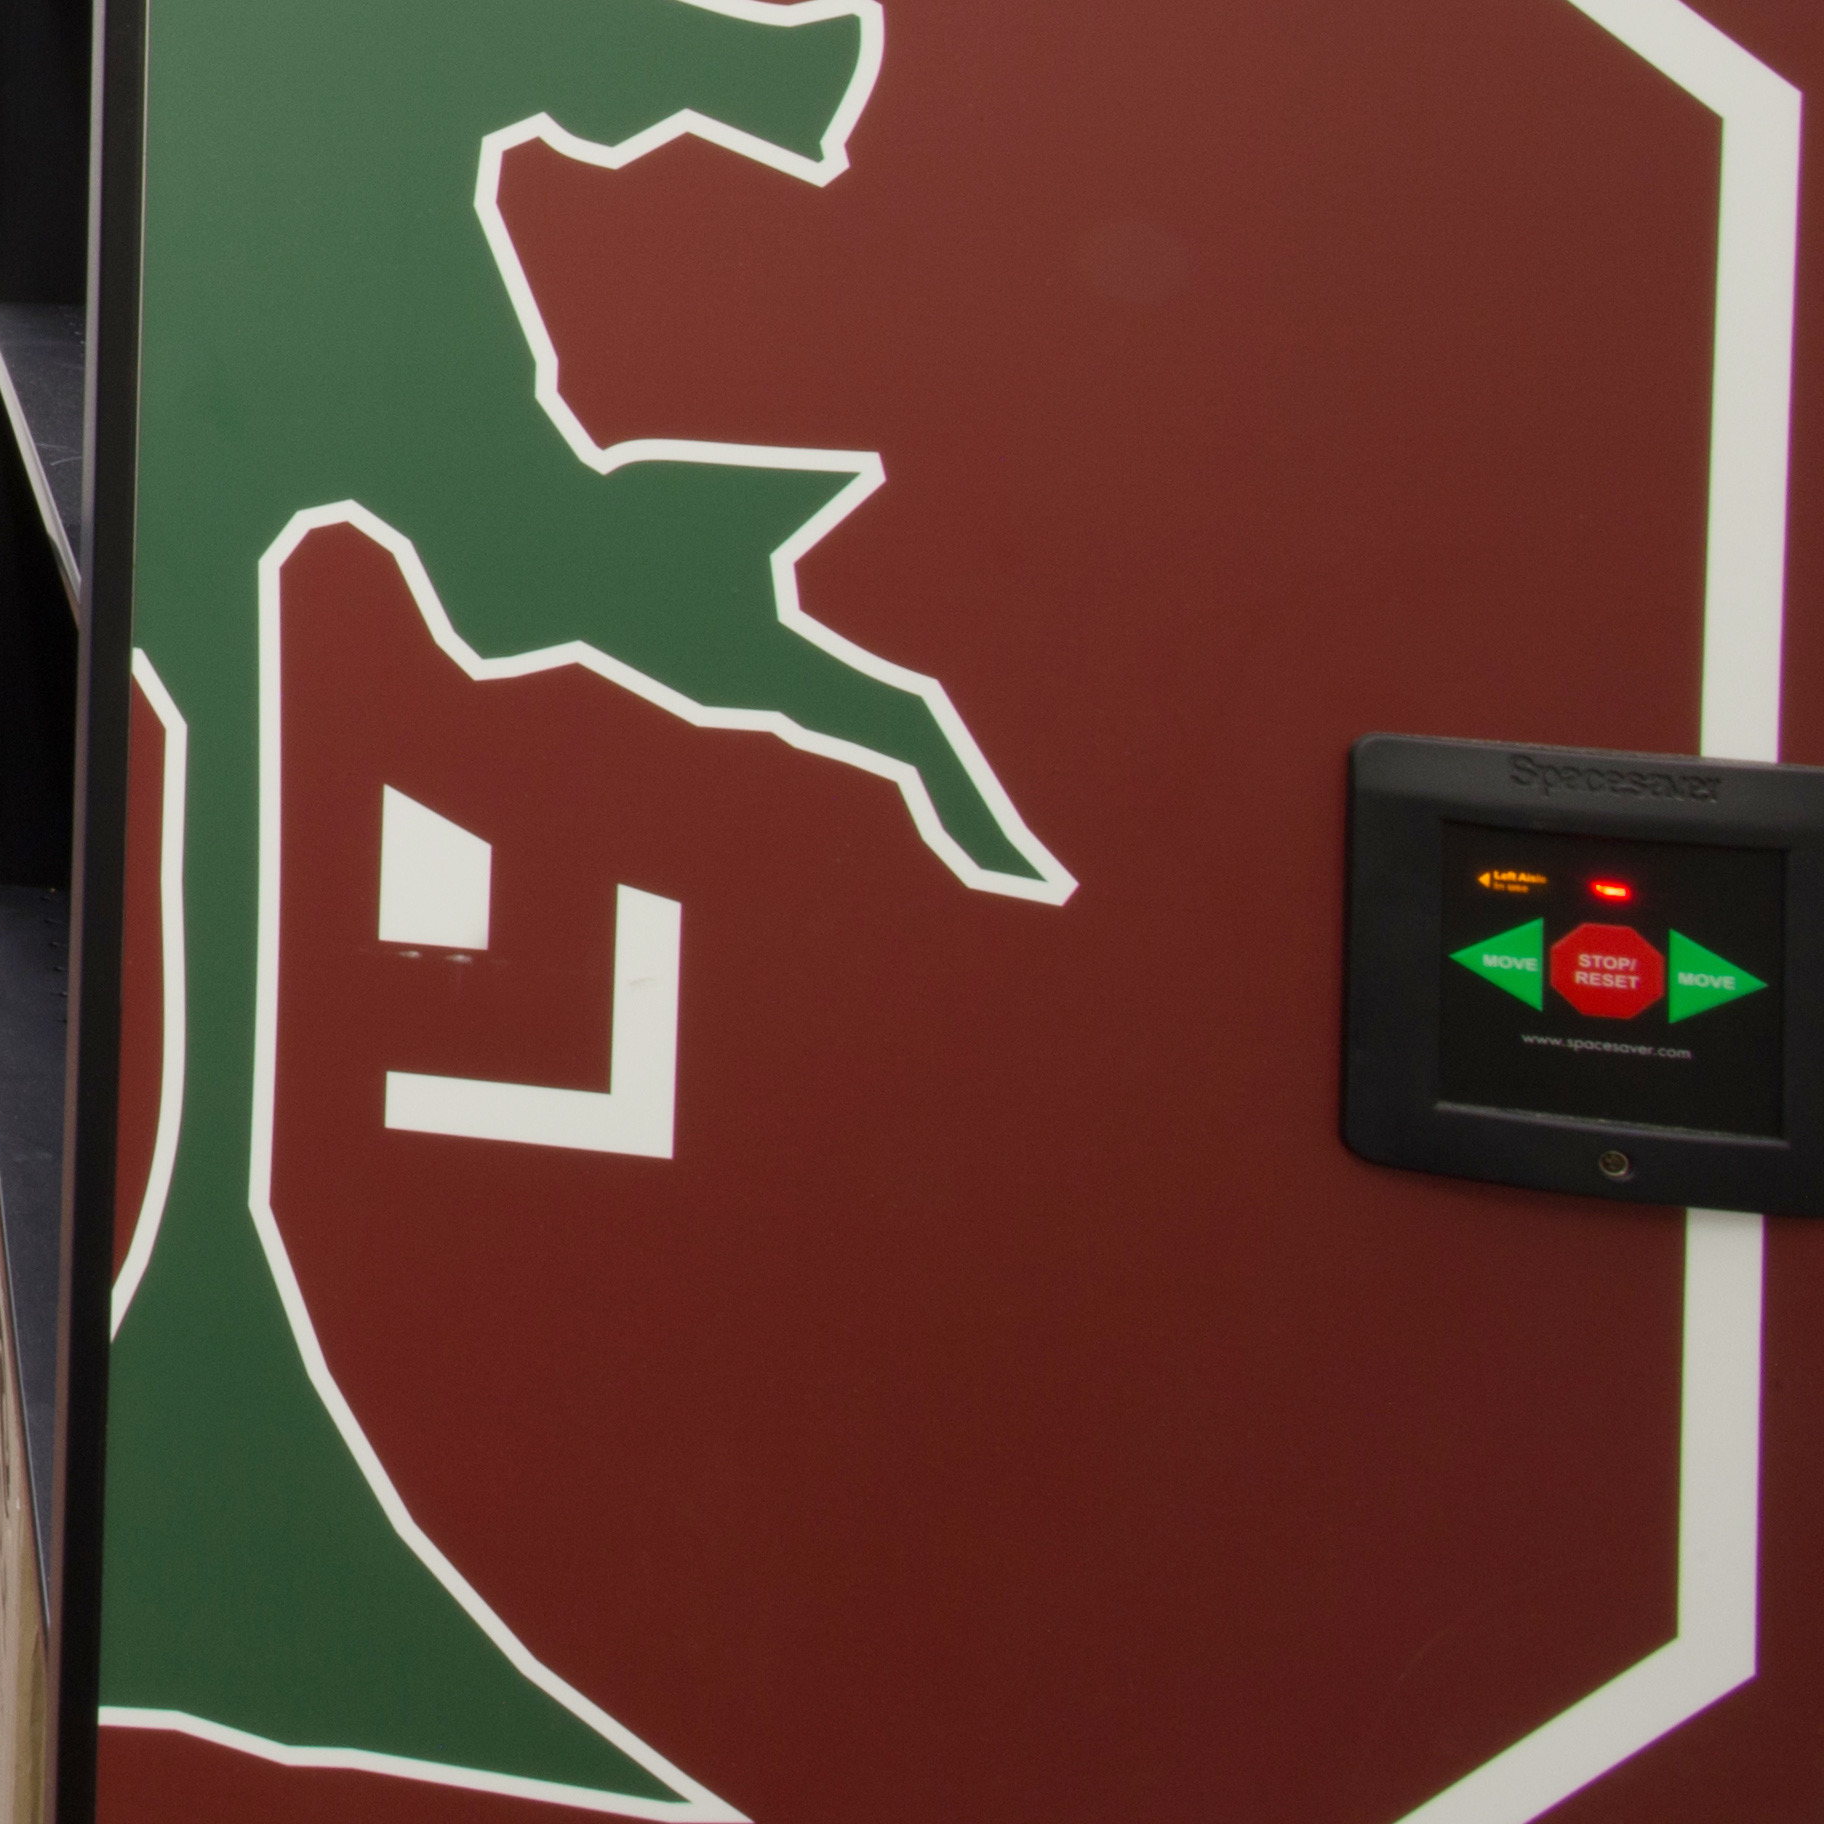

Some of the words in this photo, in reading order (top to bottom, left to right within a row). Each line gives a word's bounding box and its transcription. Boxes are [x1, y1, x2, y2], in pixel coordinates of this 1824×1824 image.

[1510, 754, 1723, 803] Spacesaver
[1482, 954, 1539, 972] MOVE
[1578, 953, 1638, 972] STOP/
[1574, 970, 1640, 989] RESET
[1677, 972, 1736, 990] MOVE
[1521, 1034, 1693, 1060] www.spacesaver.com
